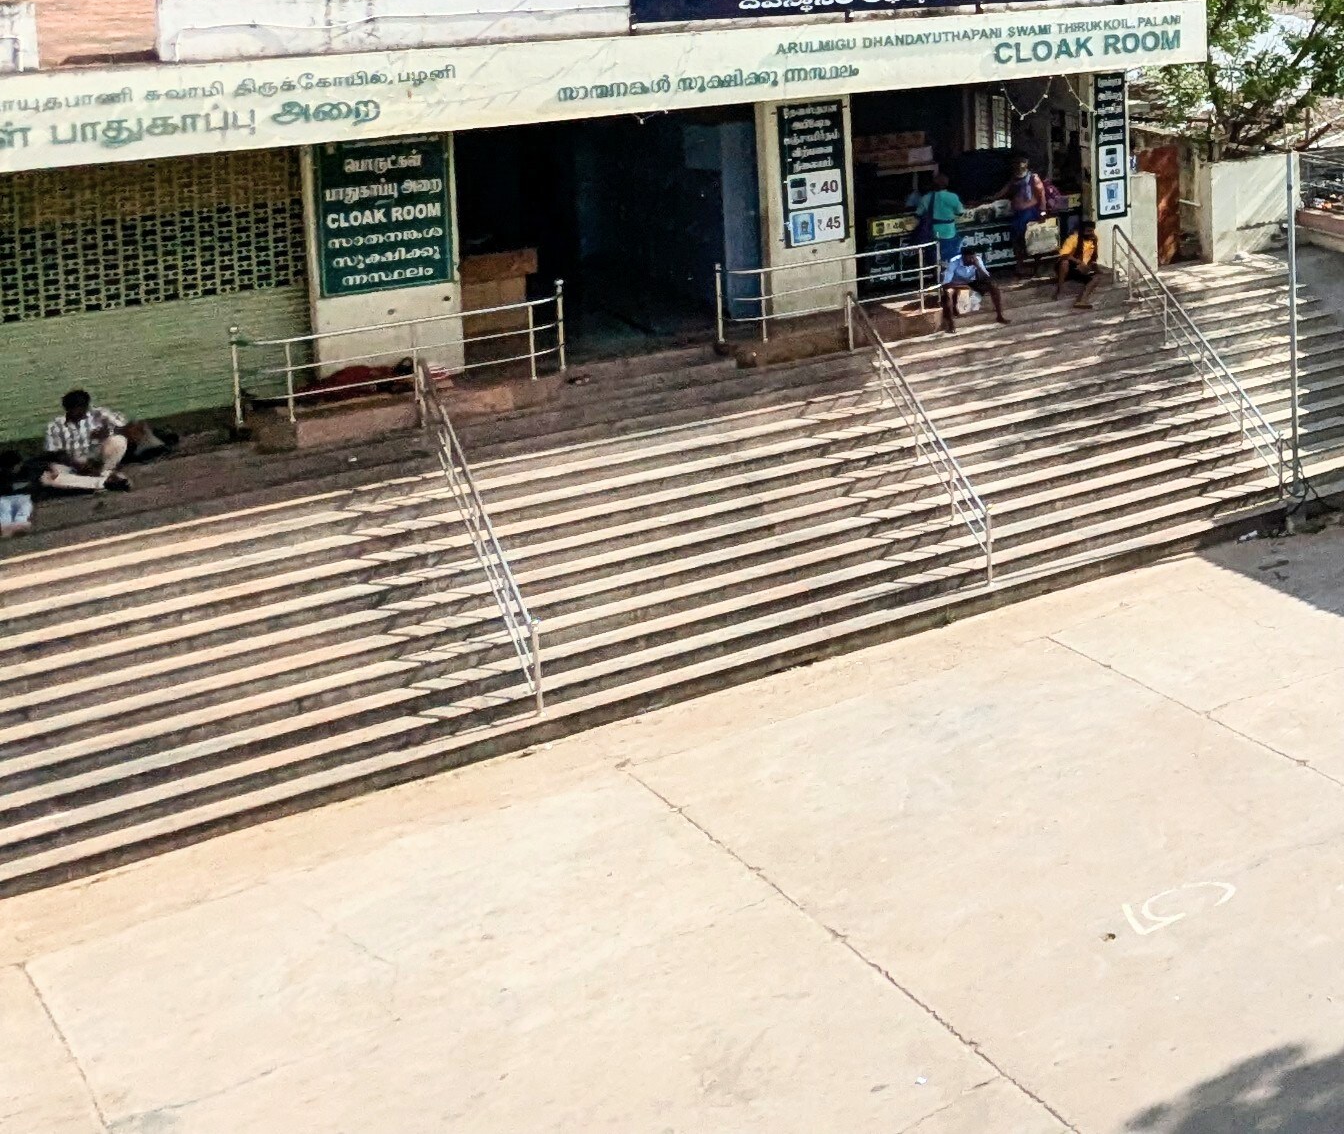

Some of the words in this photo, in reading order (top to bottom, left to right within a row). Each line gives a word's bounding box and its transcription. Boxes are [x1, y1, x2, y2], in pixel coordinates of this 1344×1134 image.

[775, 37, 857, 55] ARULMIGU
[862, 26, 1001, 49] DHANDAYUTHAPANI
[1007, 23, 1052, 38] SWAMI
[1137, 15, 1181, 29] PALANI
[994, 35, 1094, 64] CLOAK
[1103, 29, 1182, 56] ROOM
[50, 102, 256, 150] பாதுகாப்பு
[271, 98, 382, 126] அறை
[326, 207, 387, 229] CLOAK
[391, 202, 442, 222] ROOM
